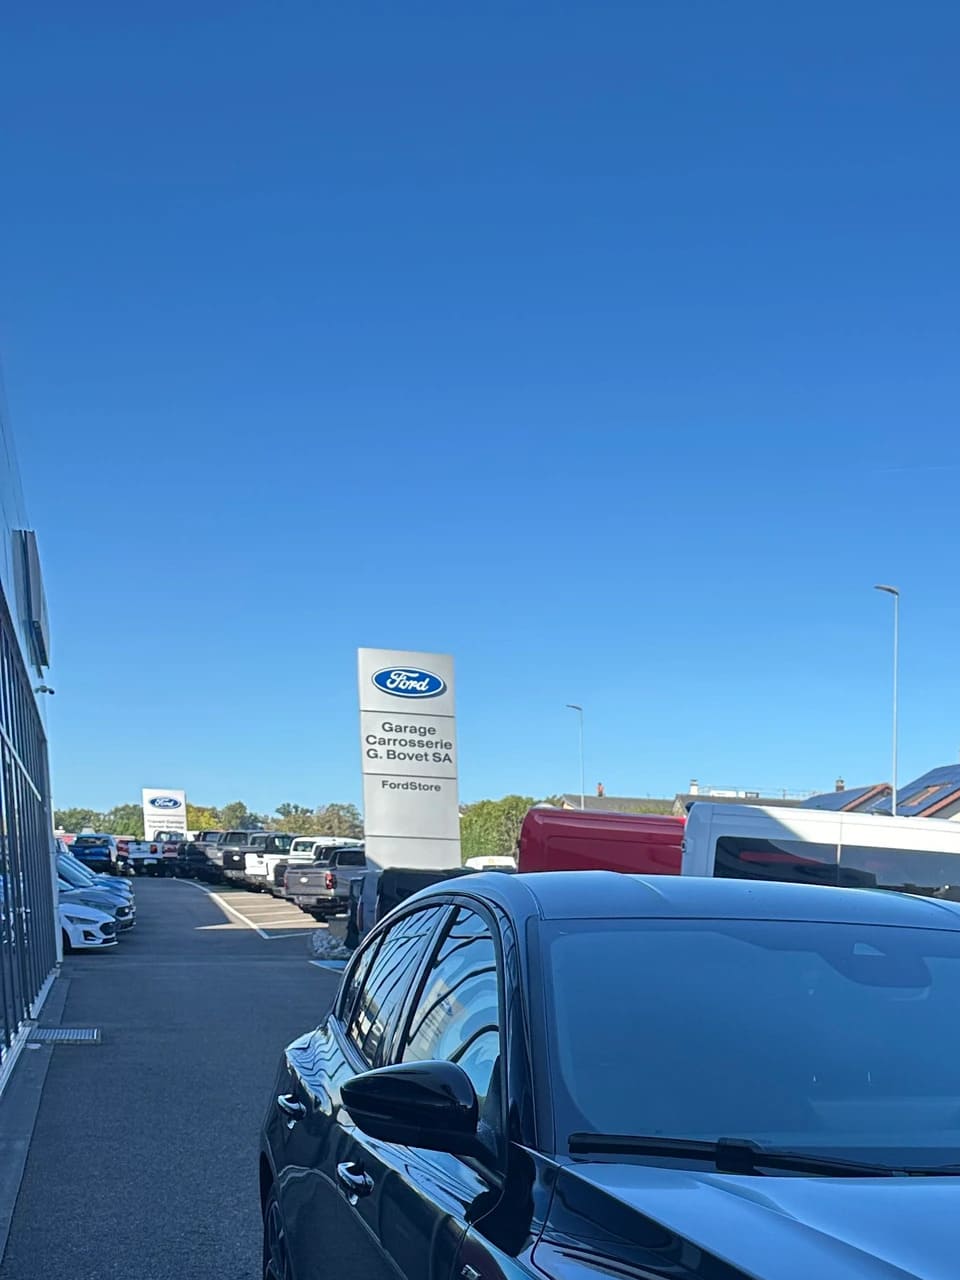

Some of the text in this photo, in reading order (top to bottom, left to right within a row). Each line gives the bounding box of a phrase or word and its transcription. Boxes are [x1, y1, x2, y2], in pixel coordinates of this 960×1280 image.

[386, 670, 429, 691] Ford
[381, 721, 436, 737] Garage
[365, 734, 453, 750] Carrosserie
[366, 748, 453, 764] G. Bovet SA
[381, 780, 441, 791] FordStore
